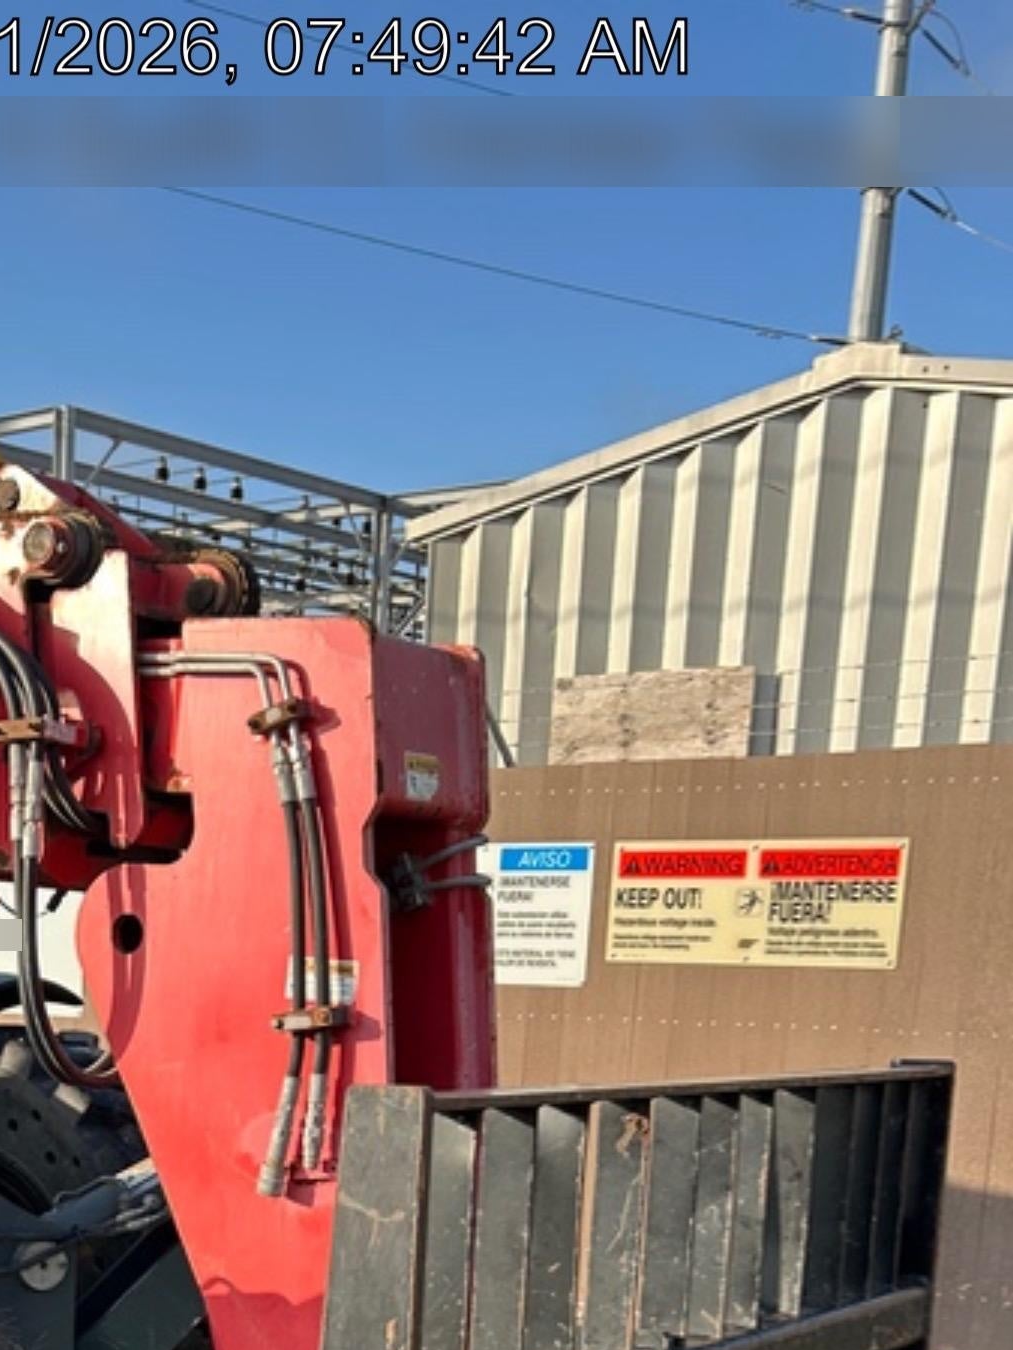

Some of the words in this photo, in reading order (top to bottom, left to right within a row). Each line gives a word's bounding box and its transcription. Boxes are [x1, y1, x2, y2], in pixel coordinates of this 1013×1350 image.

[517, 850, 572, 868] AVISO
[644, 854, 741, 875] WARNING
[614, 887, 660, 909] KEEP
[662, 887, 703, 910] OUT!
[767, 902, 832, 924] FUERA!
